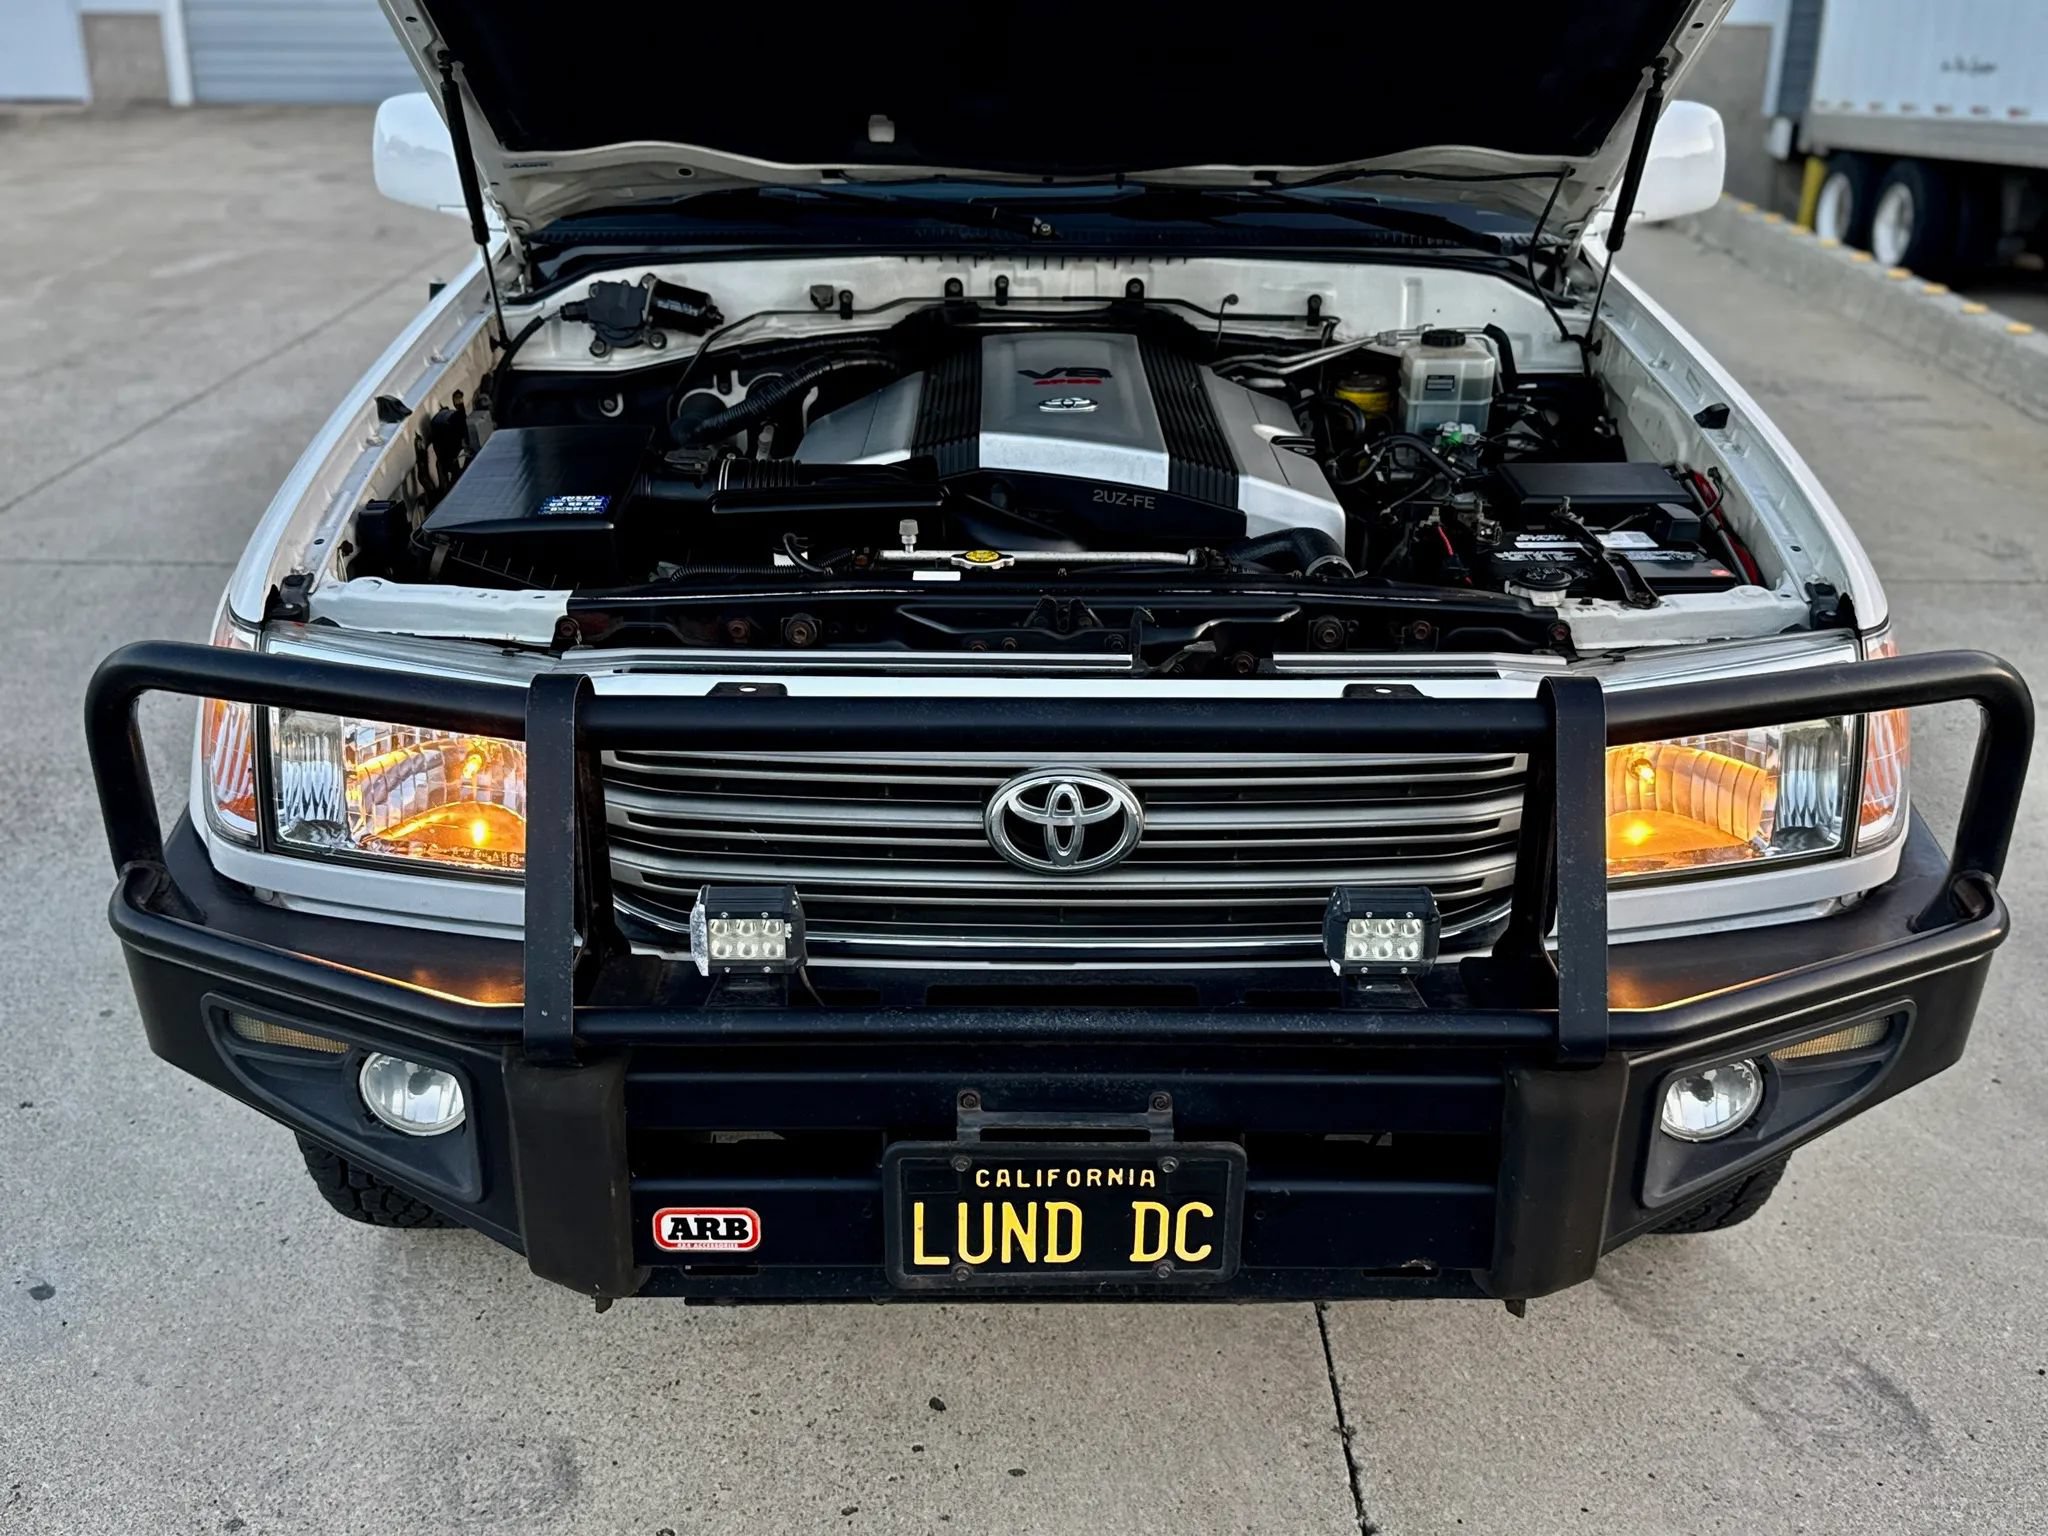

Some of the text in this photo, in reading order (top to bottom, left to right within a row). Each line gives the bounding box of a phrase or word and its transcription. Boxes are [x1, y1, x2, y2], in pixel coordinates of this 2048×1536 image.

[1092, 489, 1156, 509] 2UZ-FE
[975, 1167, 1156, 1188] CALIFORNIA
[668, 1217, 749, 1240] ARB
[914, 1201, 1214, 1265] LUND DC
